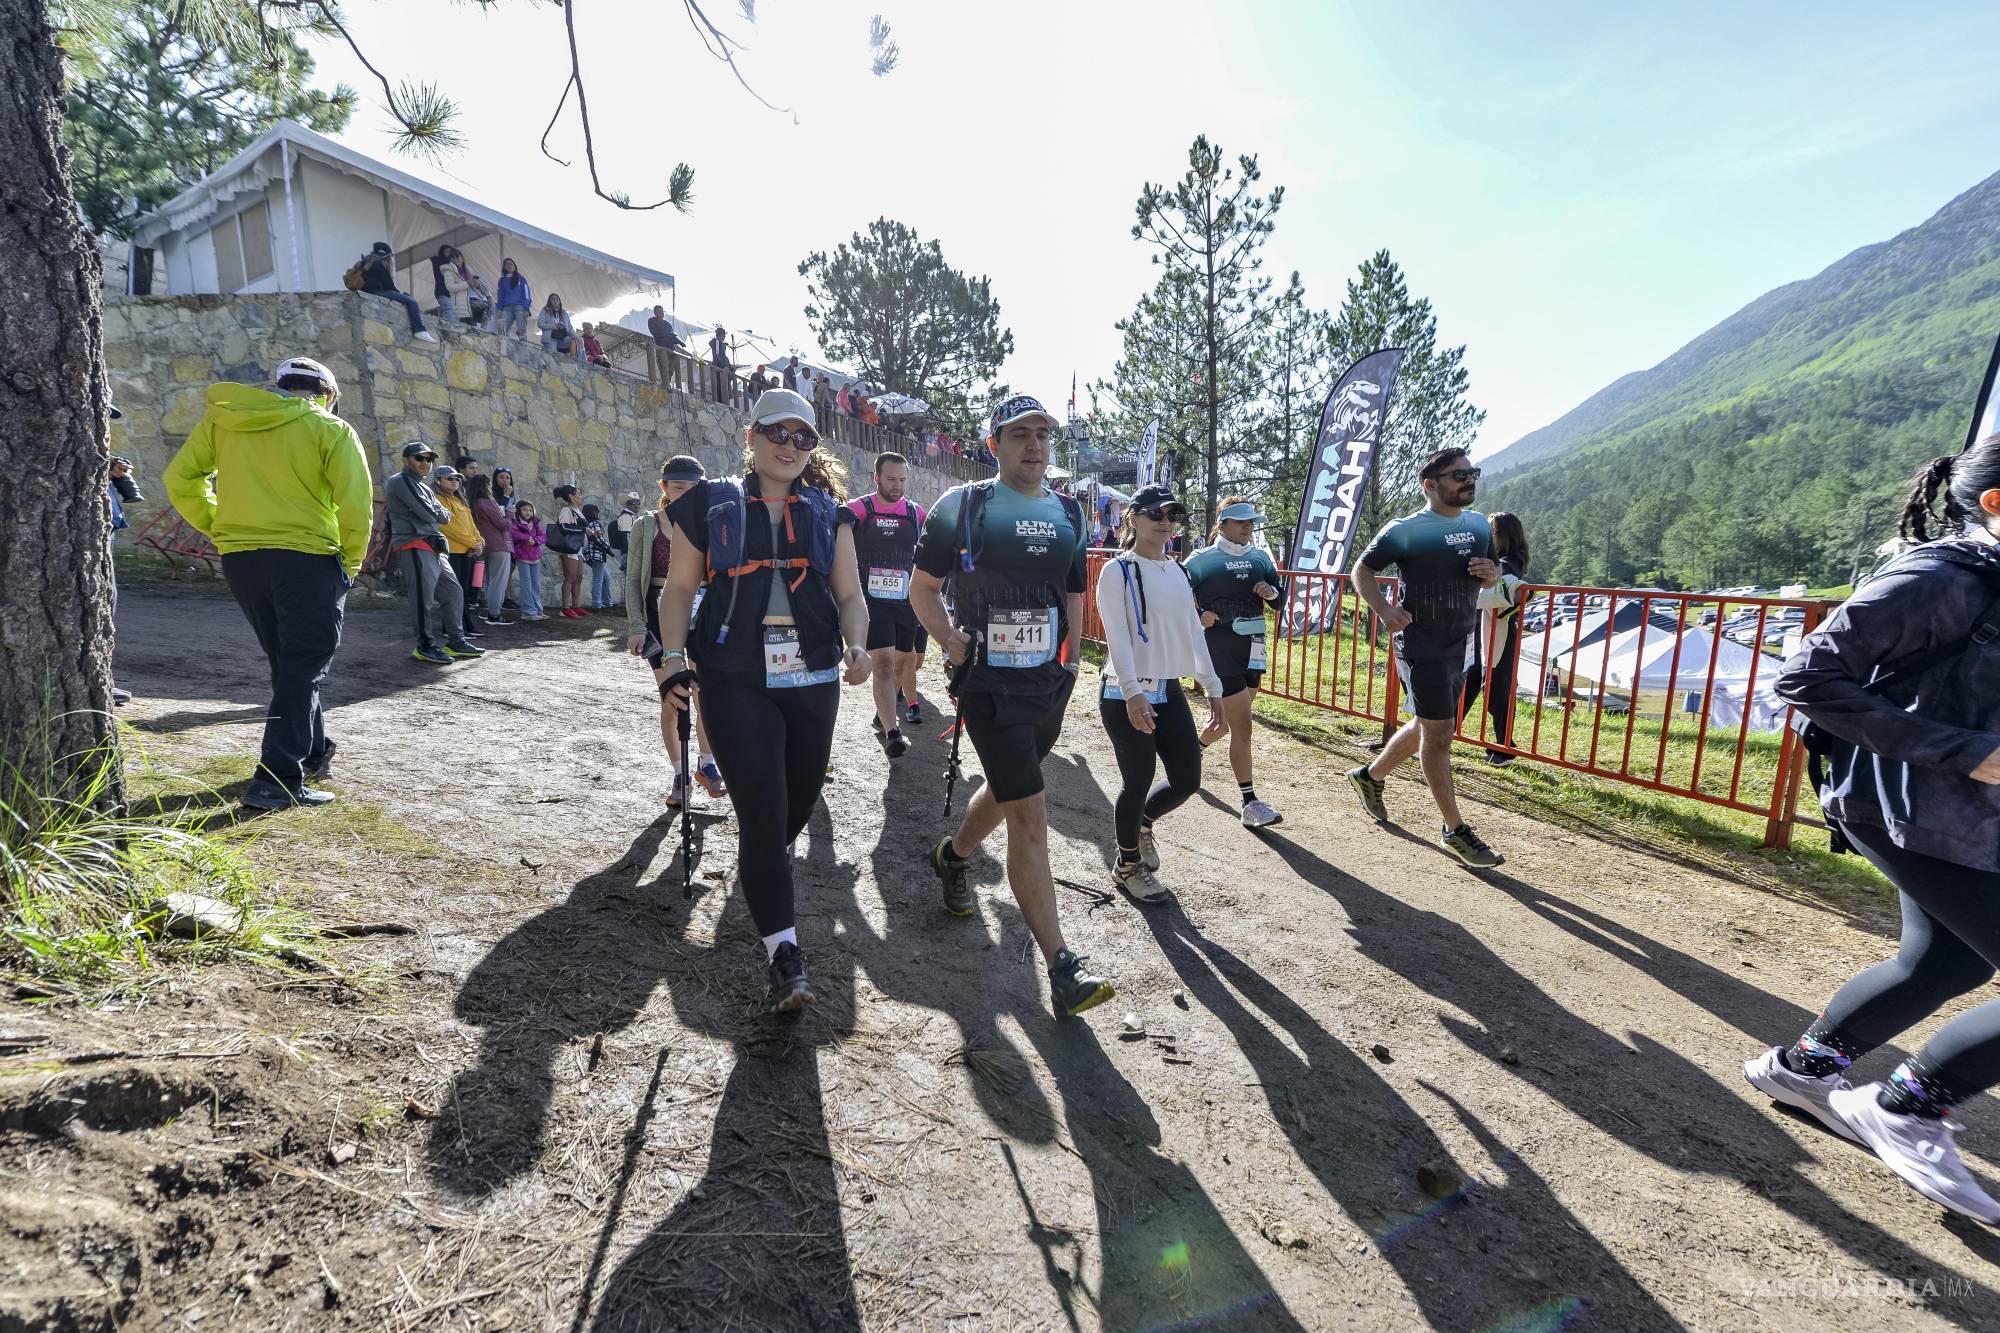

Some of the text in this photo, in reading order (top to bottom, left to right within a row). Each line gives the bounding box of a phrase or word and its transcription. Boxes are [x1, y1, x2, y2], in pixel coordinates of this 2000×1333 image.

[1297, 440, 1343, 570] ULTRA
[1318, 441, 1371, 574] COAH
[1015, 520, 1056, 530] ULTRA
[1016, 527, 1057, 537] COAH
[1446, 535, 1476, 545] COAH
[882, 577, 899, 588] 655
[1015, 626, 1042, 643] 411
[1010, 654, 1032, 665] 12K
[790, 672, 816, 687] 12K
